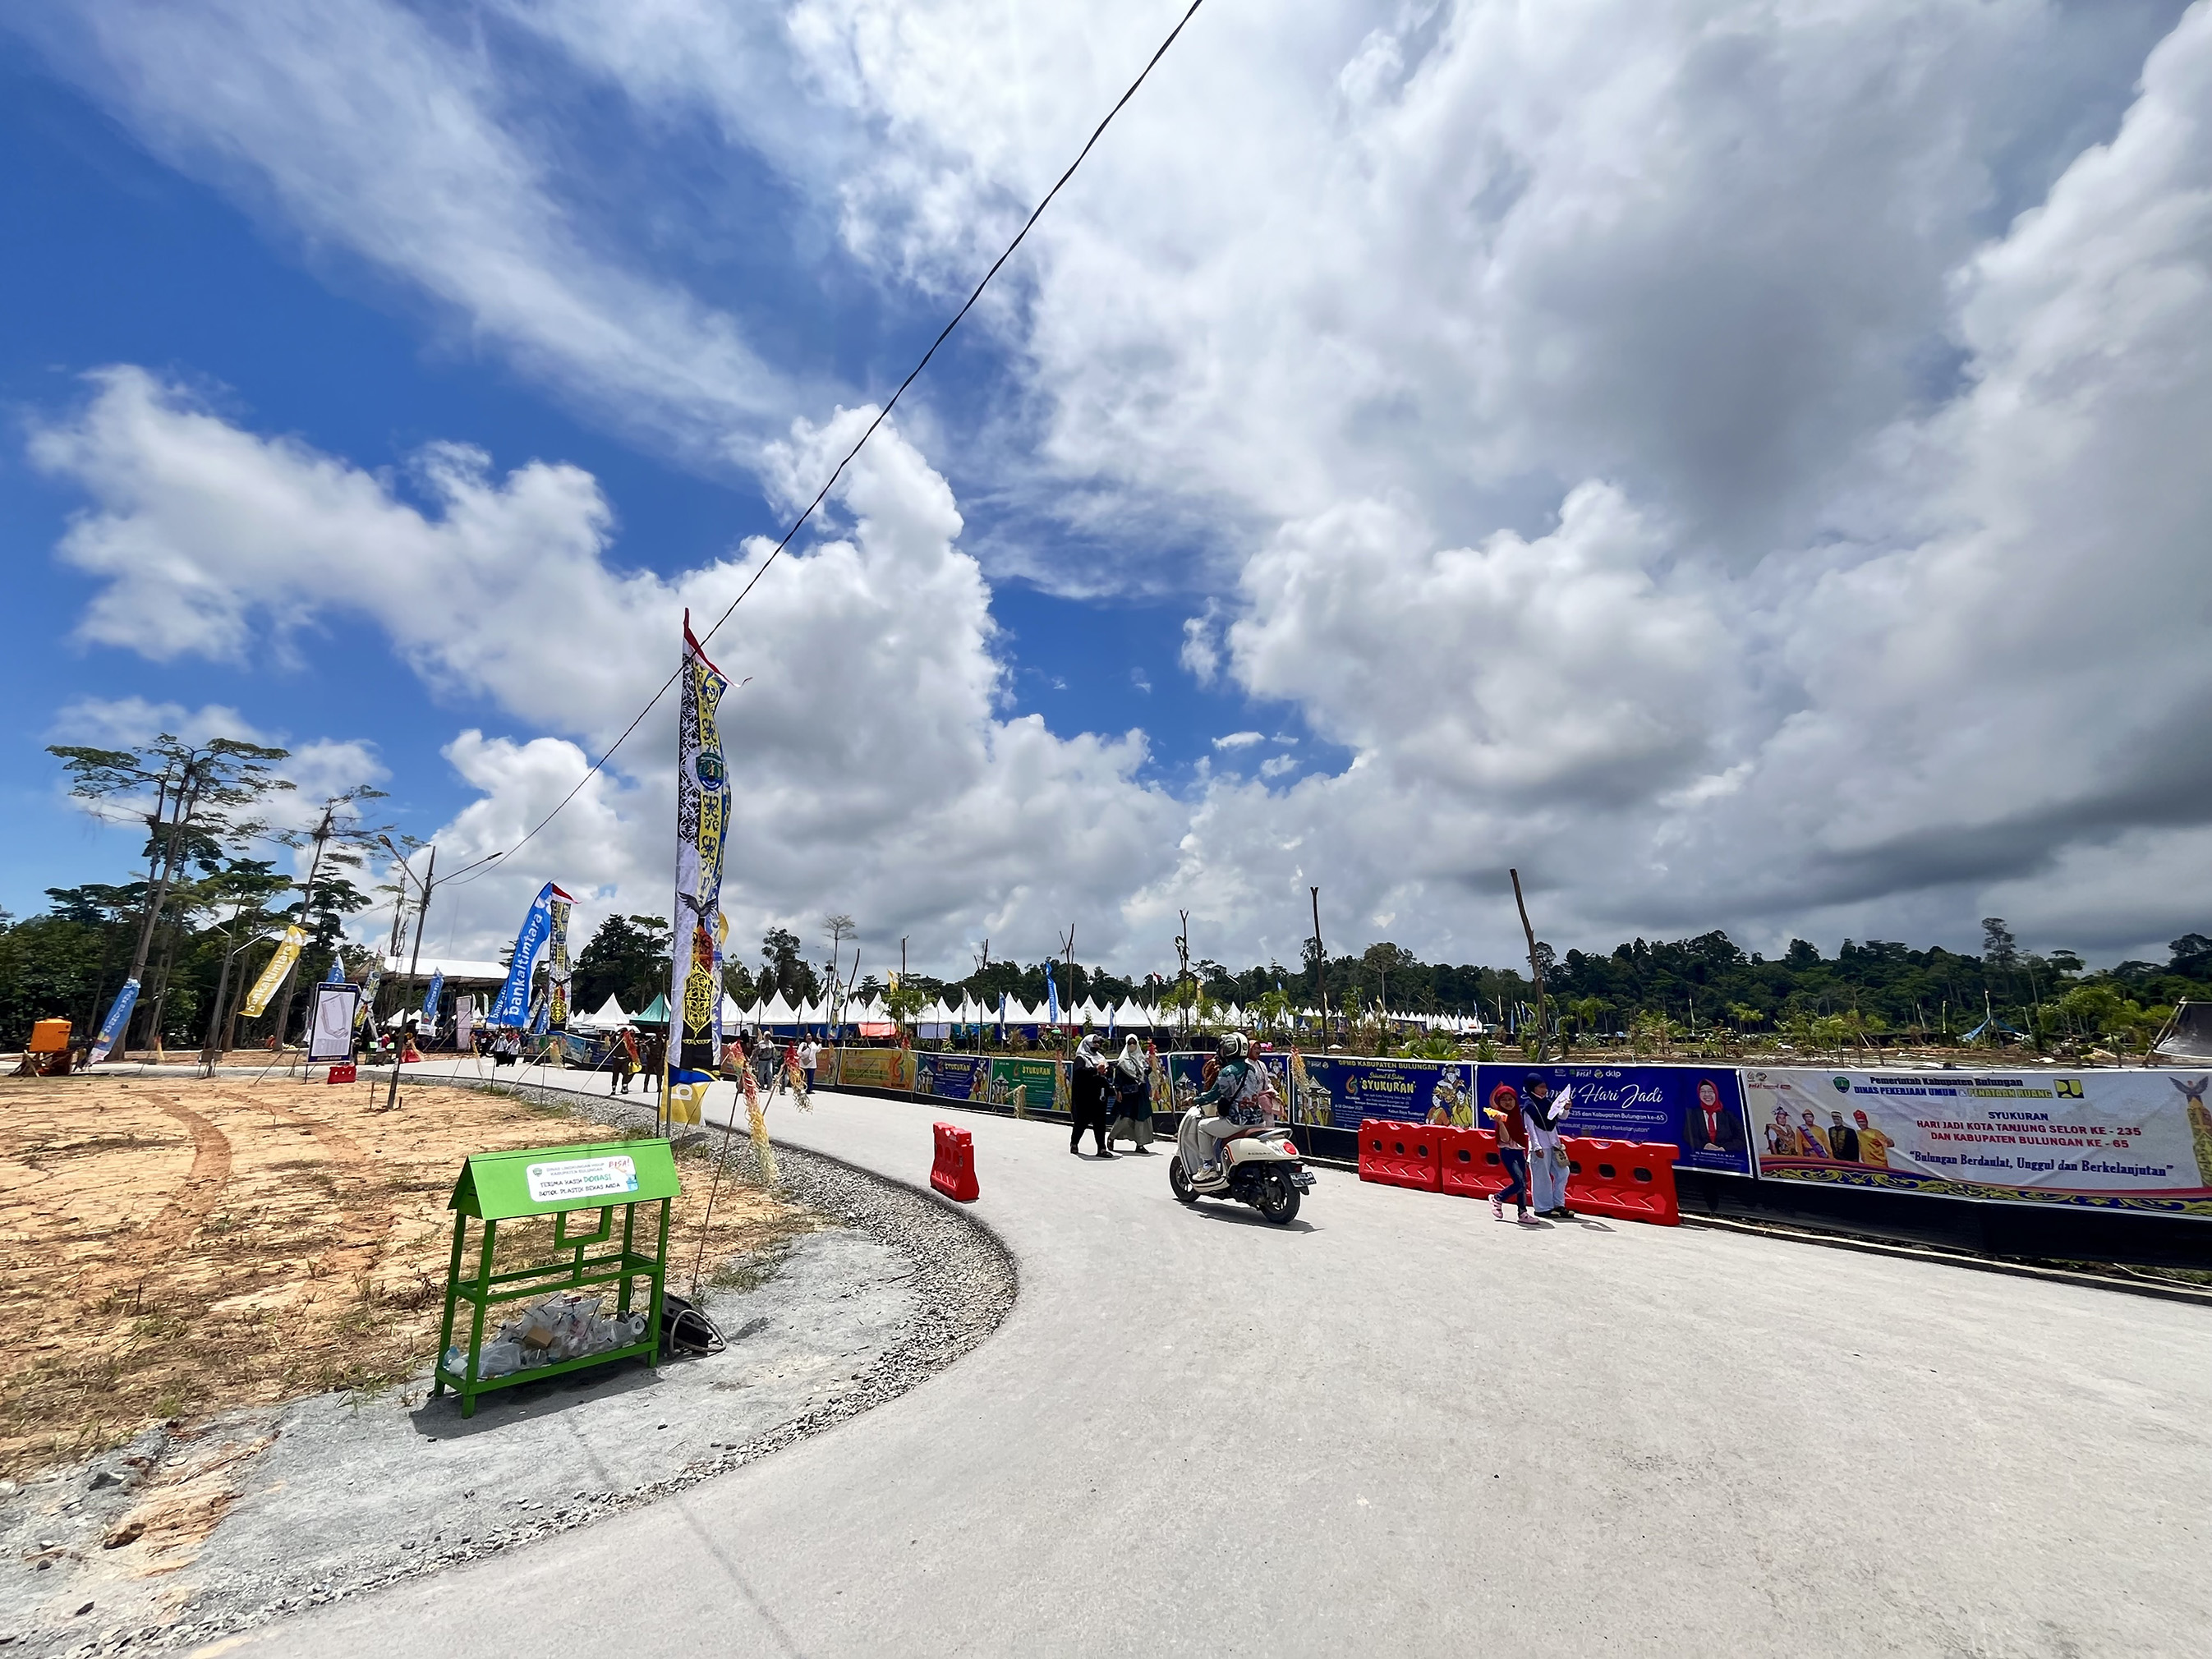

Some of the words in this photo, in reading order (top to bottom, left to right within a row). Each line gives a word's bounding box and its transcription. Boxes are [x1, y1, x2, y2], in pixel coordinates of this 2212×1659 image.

[508, 914, 543, 1016] bankaltimtara
[1357, 1060, 1396, 1068] KABUPATEN
[1398, 1063, 1437, 1071] BULUNGAN
[1361, 1079, 1414, 1094] SYUKURAN
[1869, 1076, 1921, 1085] Pemerintah
[1922, 1078, 1973, 1086] Kabupaten
[1975, 1078, 2024, 1087] Bulungan
[1578, 1083, 1619, 1104] Hari
[1621, 1084, 1663, 1109] Jadi
[1880, 1087, 1928, 1096] PEKERJAAN
[1928, 1088, 1957, 1096] UMUM
[1967, 1088, 2017, 1098] PENATAAN
[2017, 1089, 2053, 1098] RUANG
[1592, 1111, 1621, 1120] Kabupaten
[1988, 1111, 2049, 1121] SYUKURAN
[1916, 1120, 1940, 1128] HARI
[1943, 1121, 1963, 1129] JADI
[1966, 1122, 1994, 1131] KOTA
[1995, 1123, 2047, 1133] TANJUNG
[2049, 1125, 2087, 1134] SELOR
[2090, 1126, 2107, 1135] KE
[2117, 1127, 2142, 1136] 235
[1930, 1132, 1951, 1141] DAN
[1953, 1133, 2017, 1144] KABUPATEN
[2019, 1136, 2083, 1147] BULUNGAN
[2086, 1138, 2102, 1147] KE
[2113, 1139, 2129, 1148] 65
[609, 1158, 630, 1168] BISA!
[1961, 1154, 2013, 1169] Berdaulat,
[2017, 1156, 2054, 1172] Unggul
[2058, 1160, 2077, 1171] dan
[583, 1174, 612, 1183] DONASI
